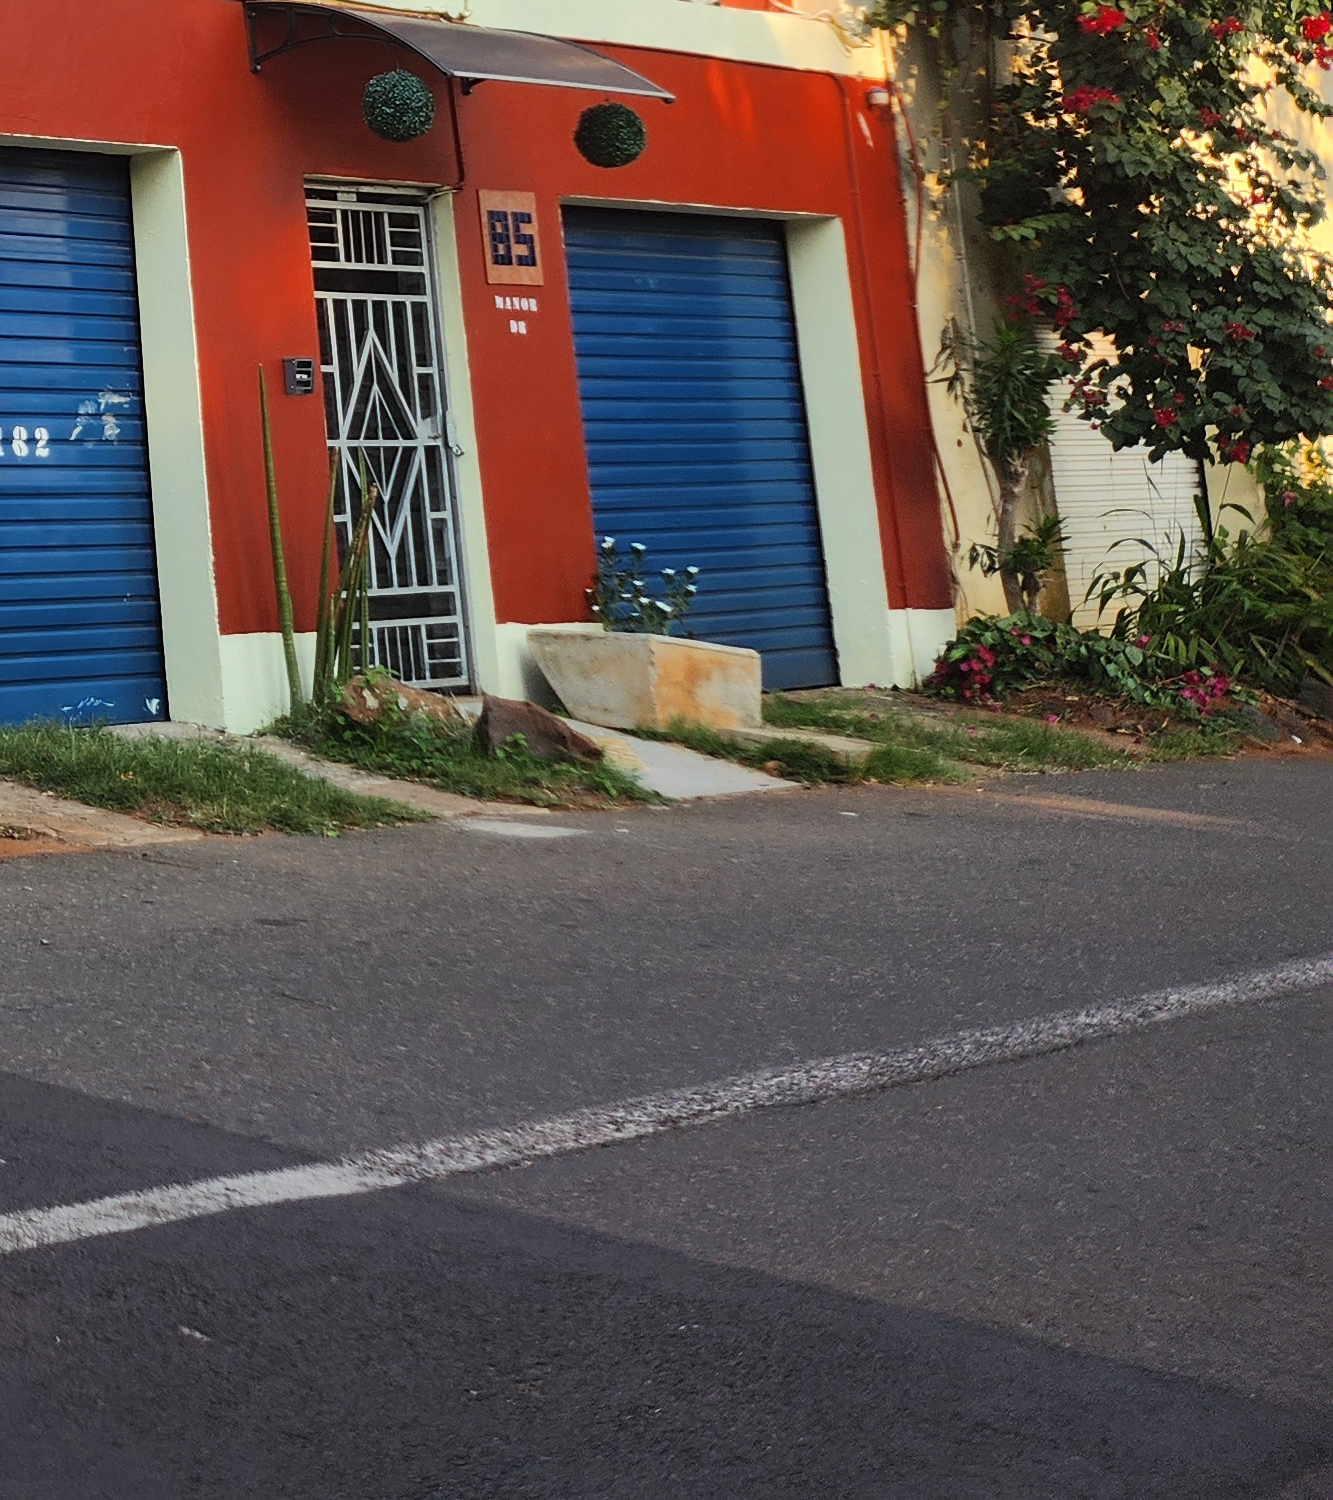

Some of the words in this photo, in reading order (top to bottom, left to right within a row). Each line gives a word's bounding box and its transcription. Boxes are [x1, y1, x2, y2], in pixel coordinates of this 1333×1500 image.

[486, 210, 537, 267] 85
[494, 294, 537, 312] MANOR
[509, 319, 527, 335] DR
